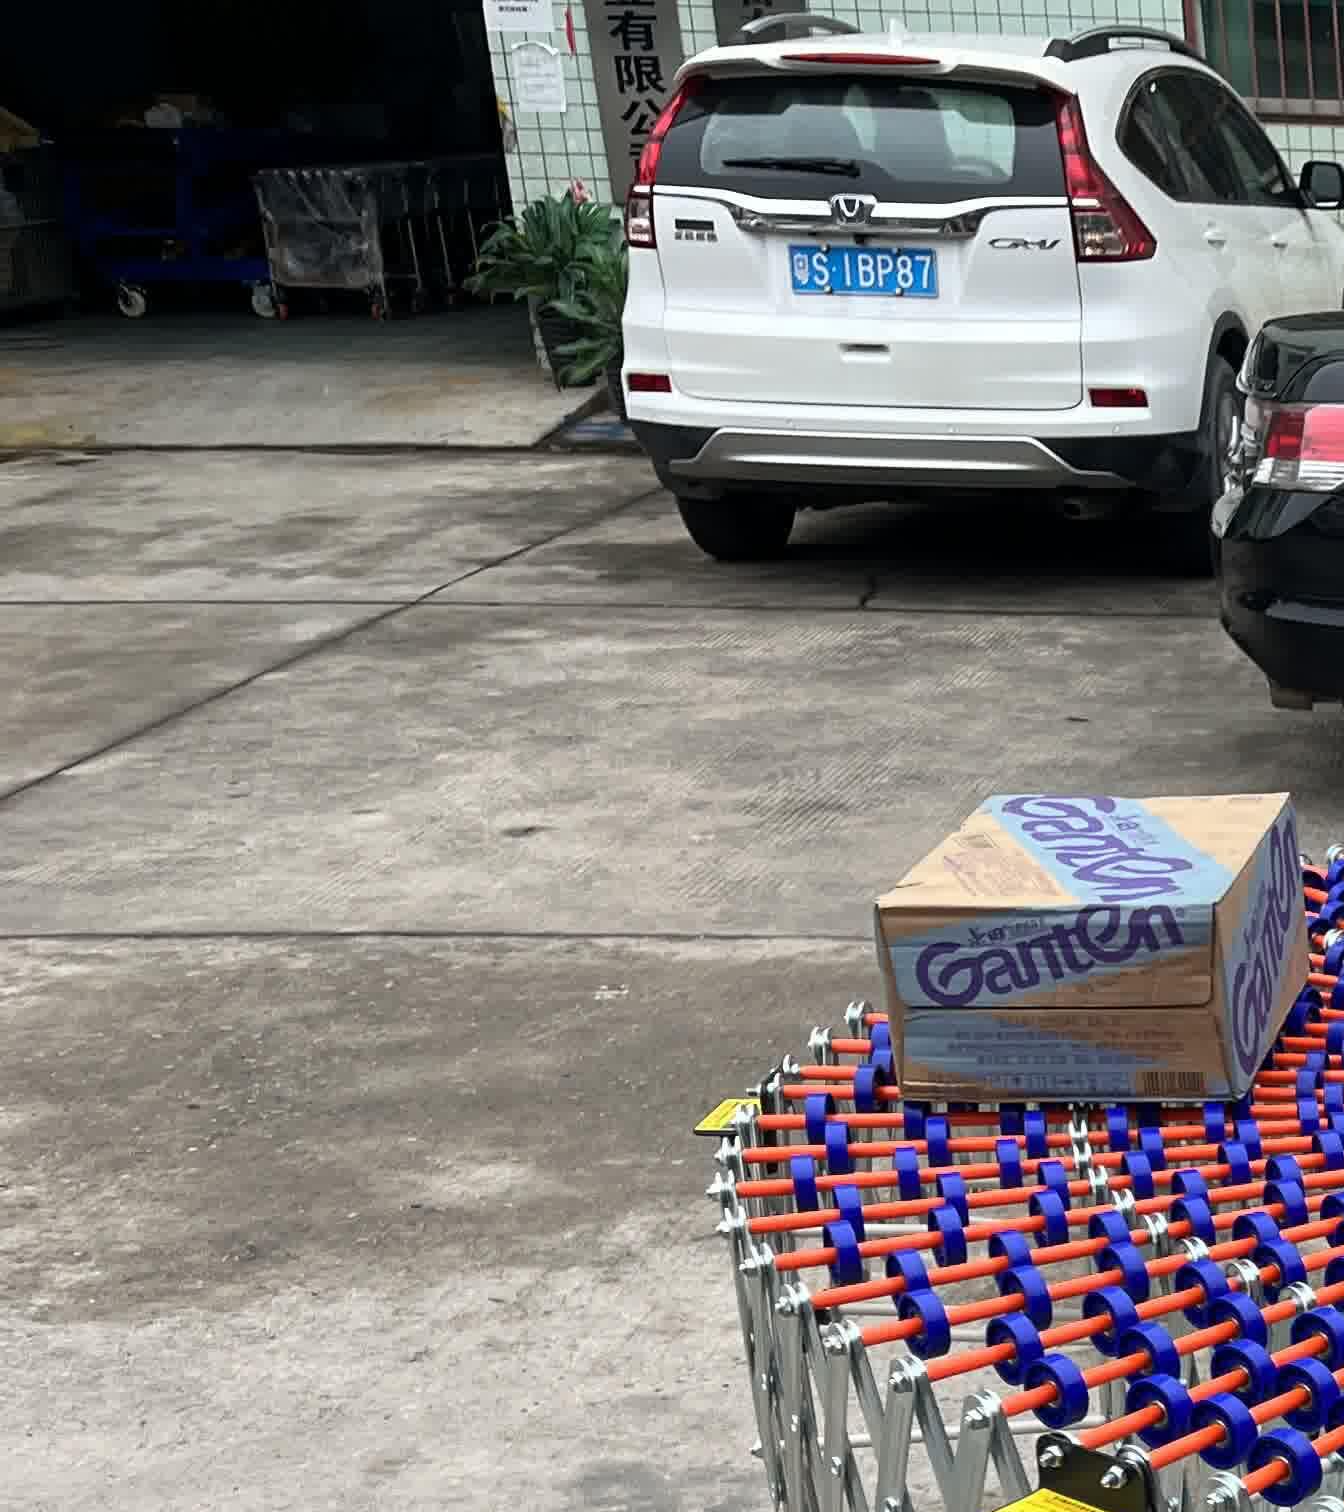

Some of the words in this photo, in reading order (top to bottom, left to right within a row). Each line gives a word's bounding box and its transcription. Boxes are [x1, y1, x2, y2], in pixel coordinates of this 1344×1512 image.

[604, 0, 667, 158] 有限公
[915, 904, 1184, 1007] Ganten
